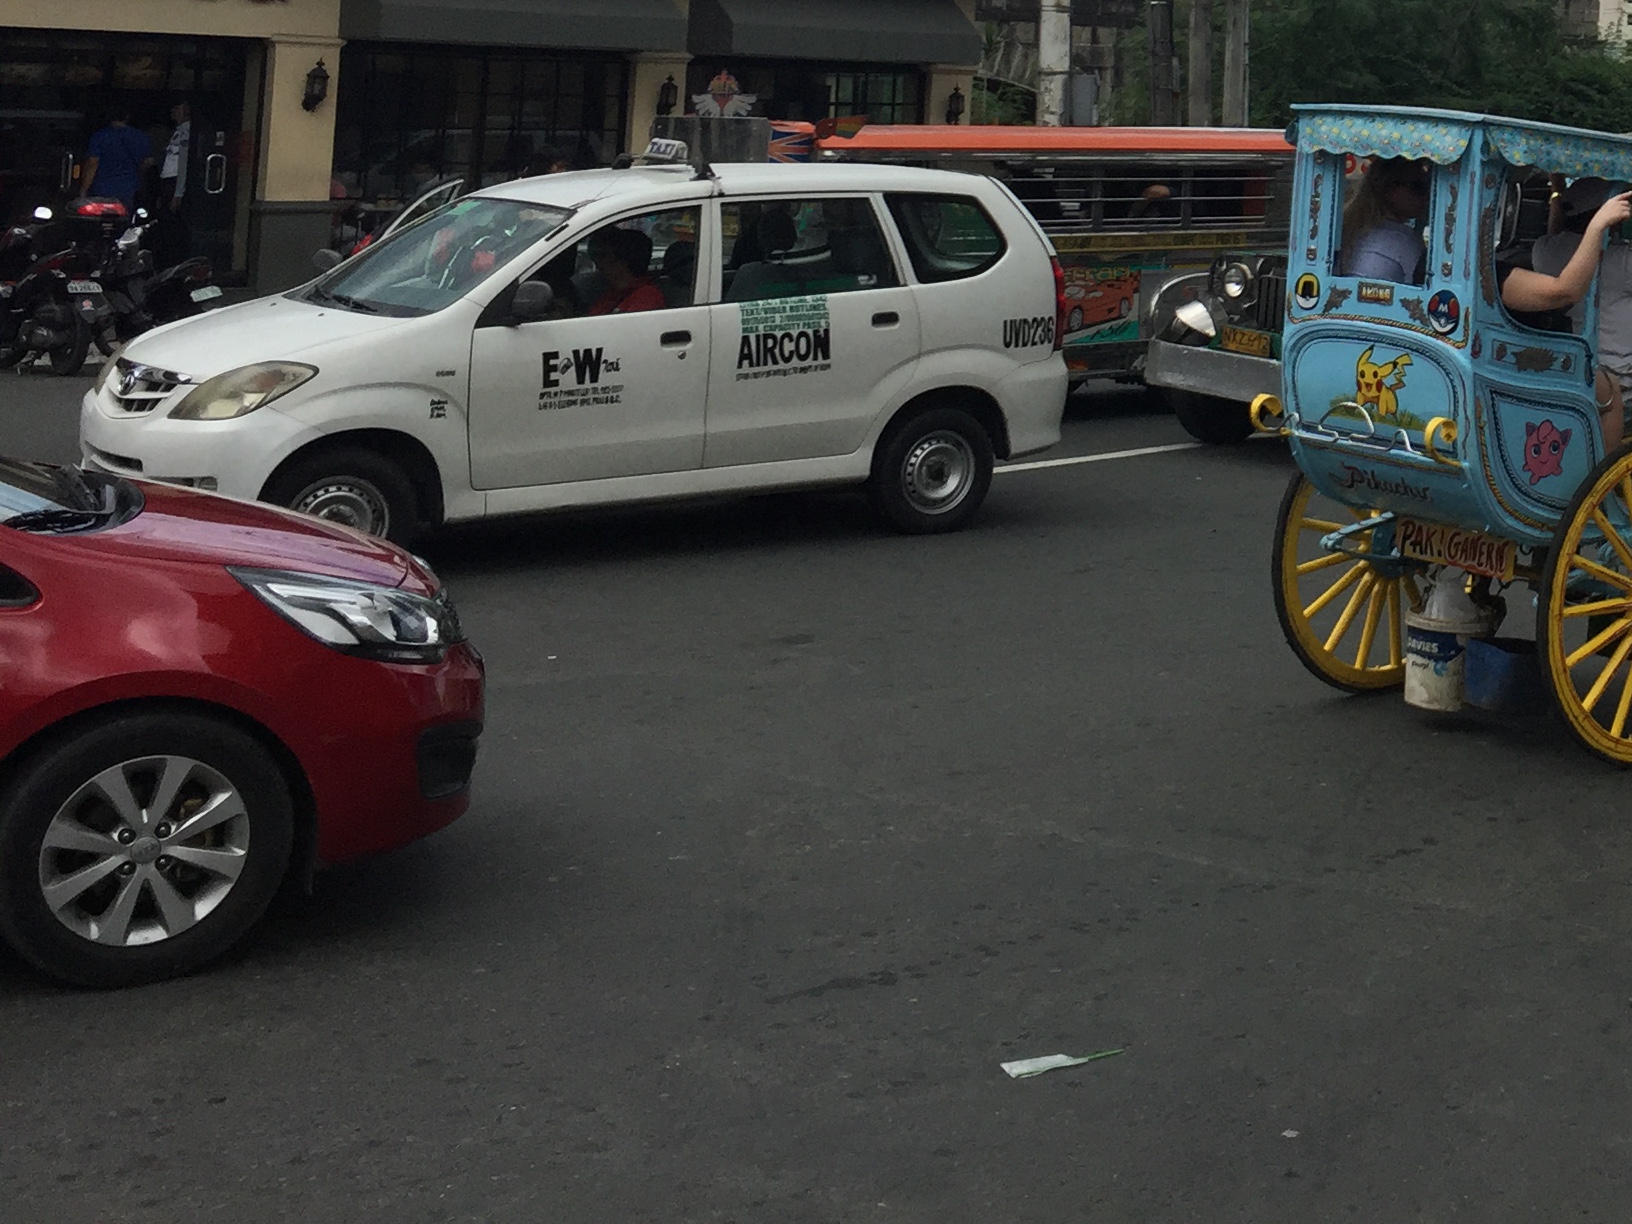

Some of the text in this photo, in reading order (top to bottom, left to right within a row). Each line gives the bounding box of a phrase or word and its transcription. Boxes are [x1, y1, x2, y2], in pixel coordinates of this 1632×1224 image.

[650, 141, 676, 156] TAXI
[737, 328, 831, 369] AIRCON
[1003, 316, 1054, 349] UVD236
